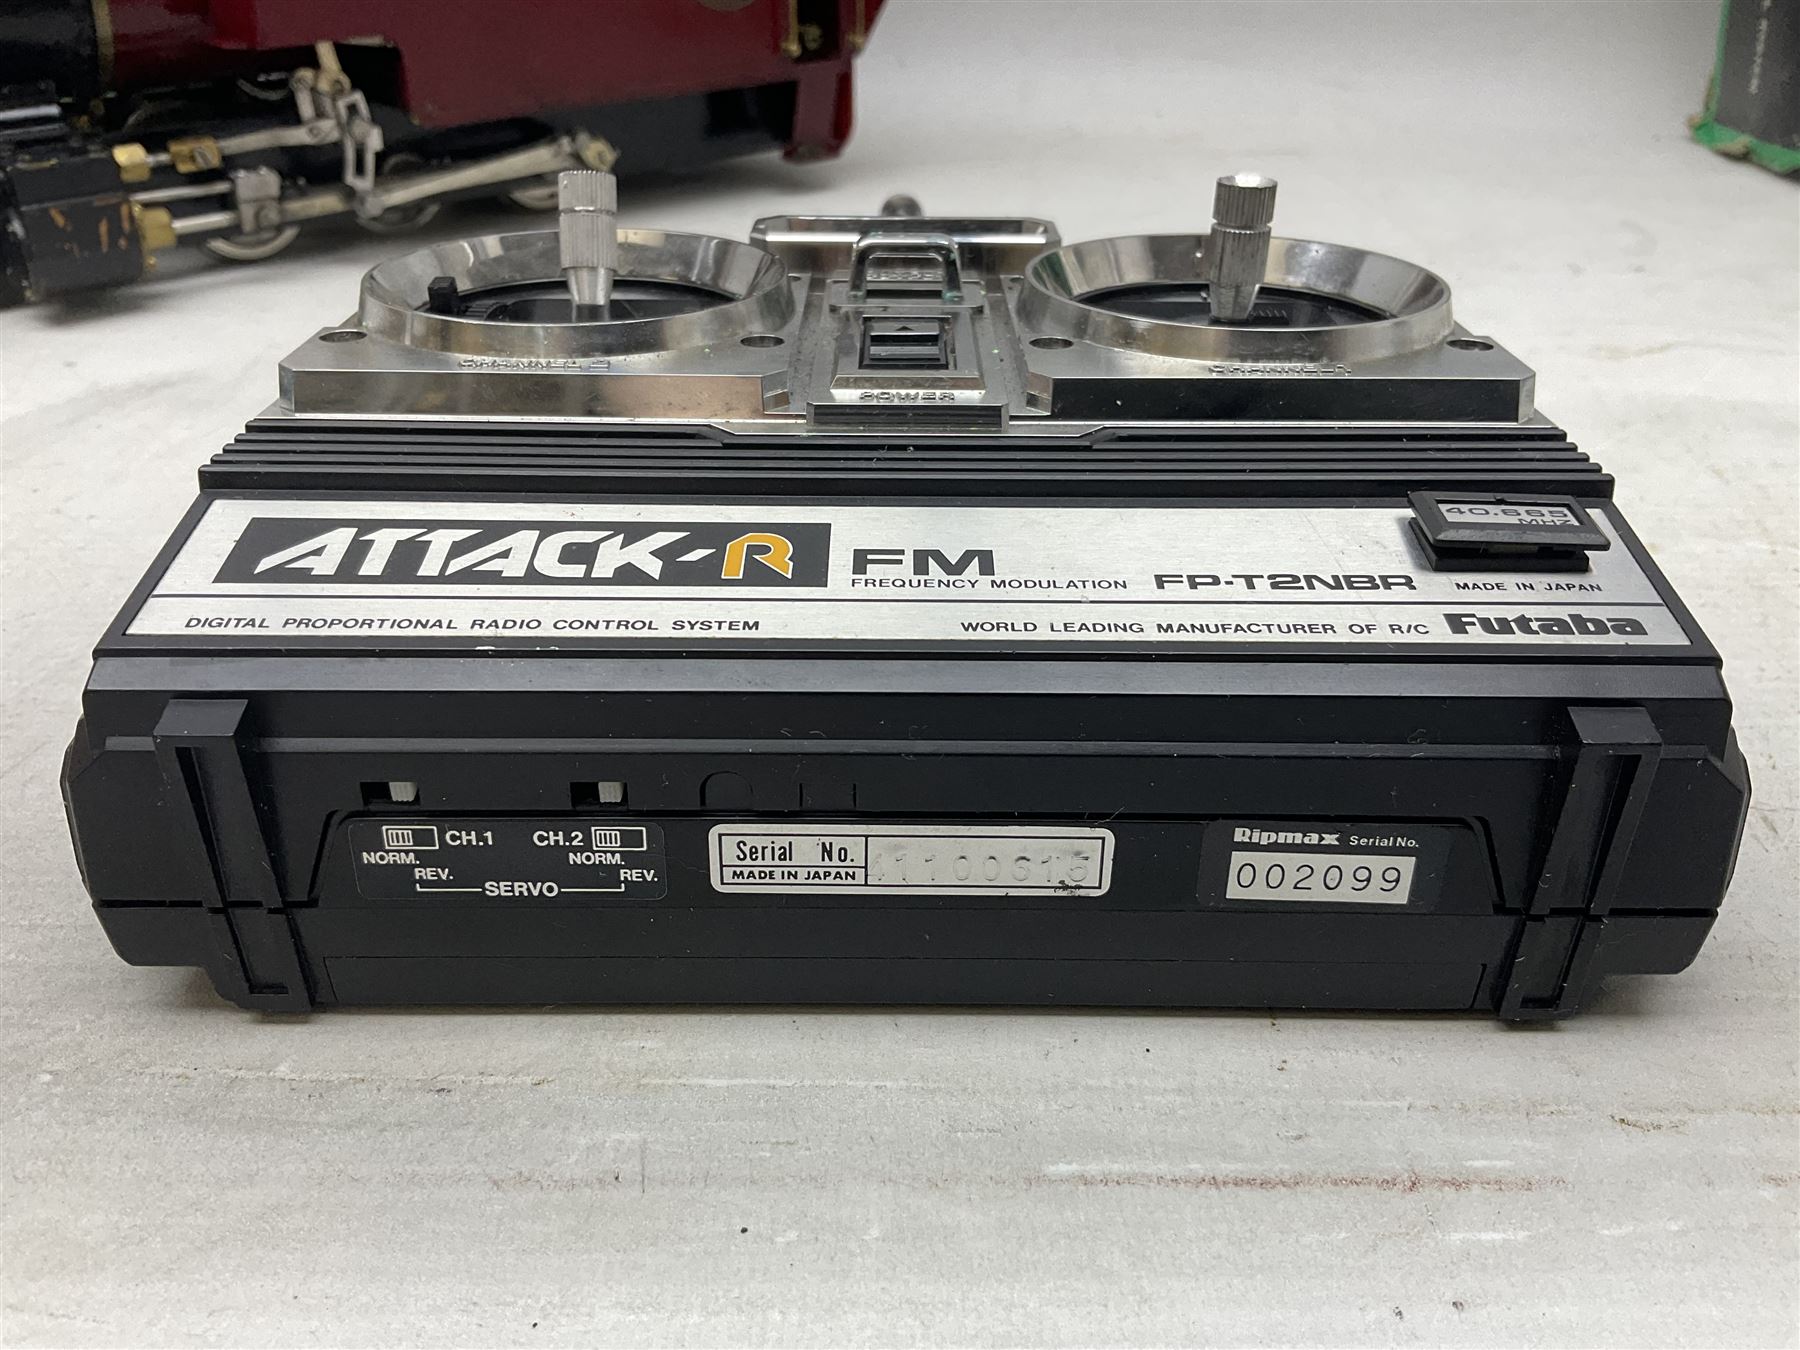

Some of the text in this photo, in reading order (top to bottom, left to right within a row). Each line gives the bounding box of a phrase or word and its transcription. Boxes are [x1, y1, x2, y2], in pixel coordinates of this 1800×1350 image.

[859, 392, 954, 402] POWER
[852, 549, 995, 576] FM
[852, 579, 1127, 589] FREQUENCY MODULATION
[1154, 574, 1416, 590] FP-T2NBR
[1545, 583, 1602, 591] JAPAN
[185, 618, 759, 630] DIGITAL PROPORTIONAL RADIO CONTROL SYSTEM
[961, 622, 1429, 634] WORLD LEADING MANUFACTURER OF R/C
[1443, 614, 1648, 635] Futaba
[446, 831, 492, 845] CH.1
[533, 831, 583, 846] CH.2
[1234, 828, 1418, 847] Ripmax Serial No.
[736, 841, 854, 862] Serial No.
[363, 852, 419, 864] NORM.
[569, 852, 625, 864] NORM.
[415, 868, 453, 880] REV.
[620, 869, 657, 881] REV.
[732, 870, 855, 880] MADE IN JAPAN
[1237, 863, 1400, 891] 002099
[485, 882, 558, 896] SERVO
